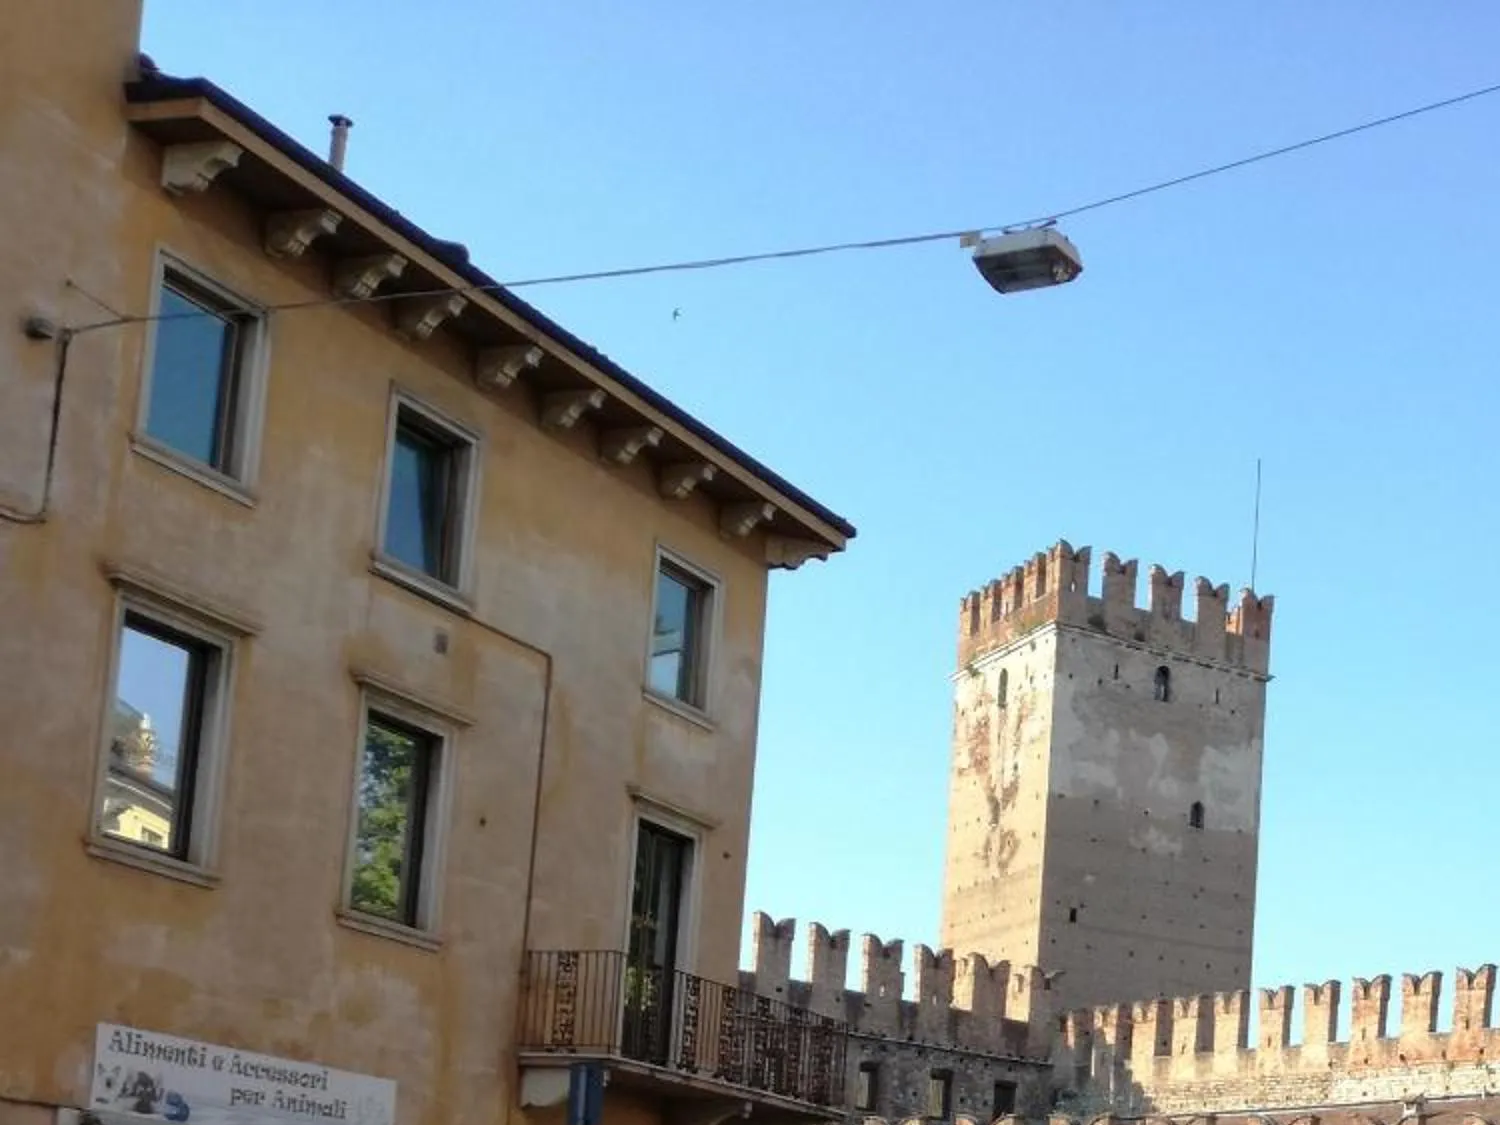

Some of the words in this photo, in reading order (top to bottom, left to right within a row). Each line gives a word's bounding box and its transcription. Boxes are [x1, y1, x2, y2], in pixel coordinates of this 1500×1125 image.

[108, 1029, 208, 1069] Alimenti
[228, 1054, 330, 1091] Accessori
[230, 1087, 265, 1107] per
[273, 1089, 348, 1120] Animali
